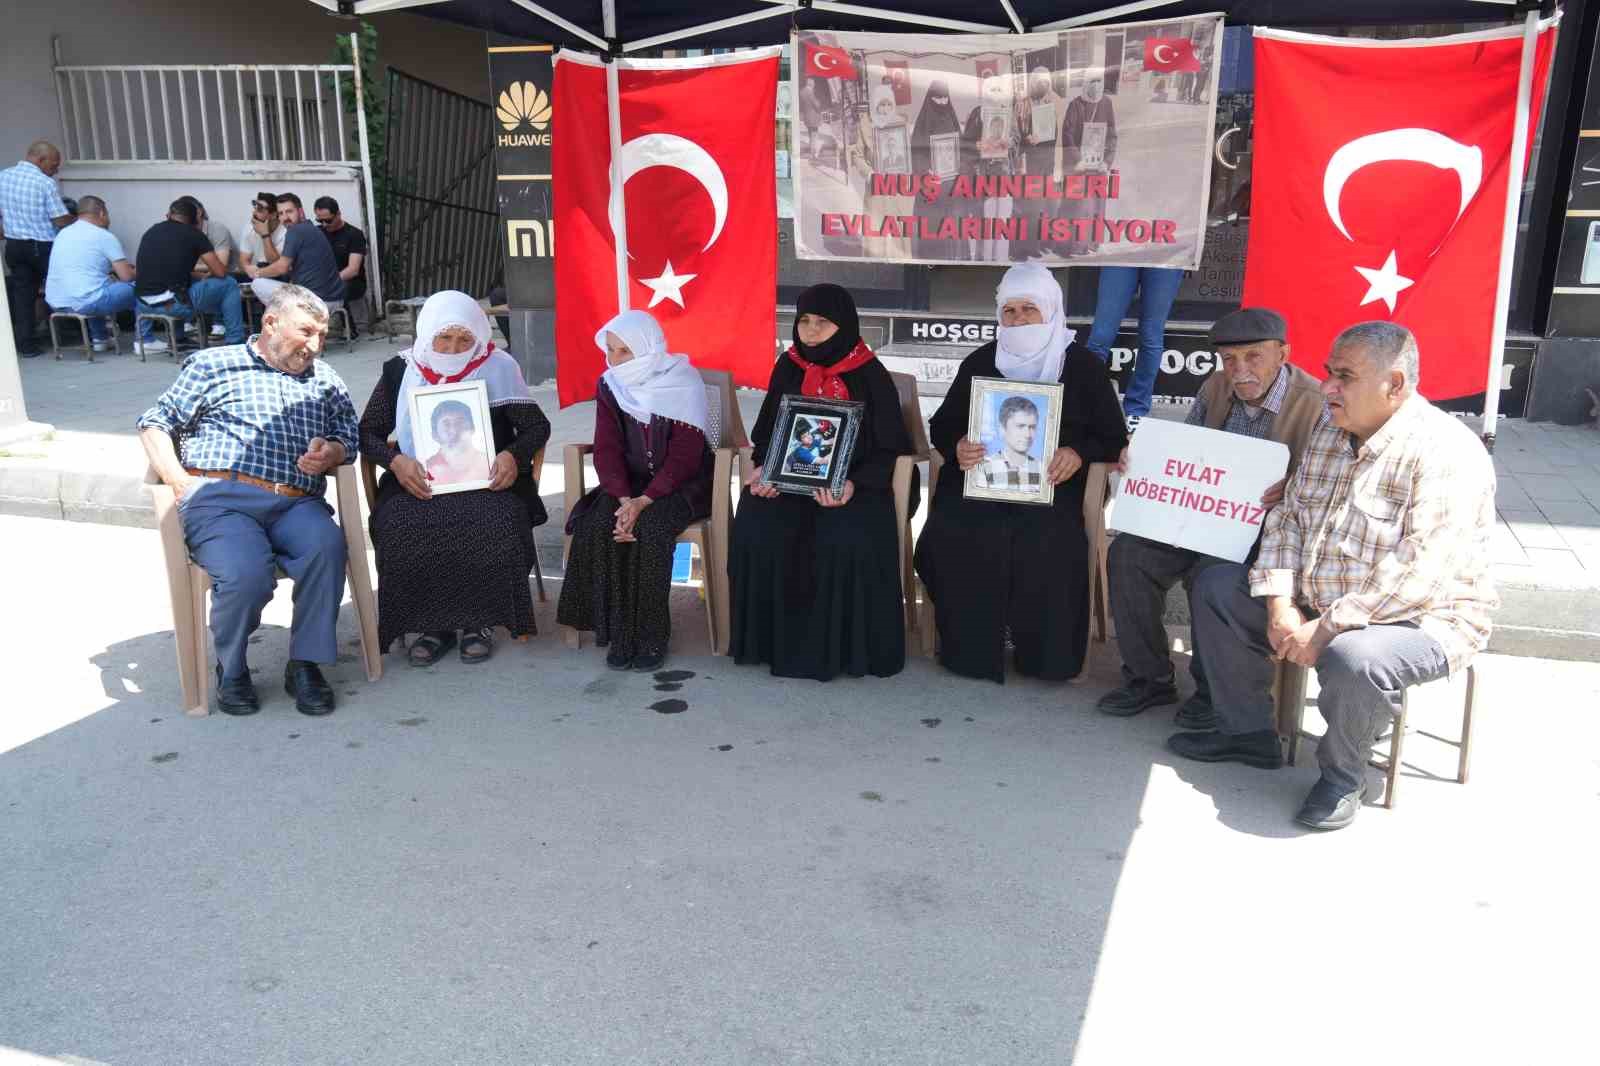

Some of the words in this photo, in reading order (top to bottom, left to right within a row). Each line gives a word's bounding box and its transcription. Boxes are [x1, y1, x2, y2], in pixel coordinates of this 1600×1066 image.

[498, 133, 553, 147] HUAWE
[872, 173, 942, 204] MUŞ
[950, 169, 1120, 200] ANNELERİ
[822, 213, 1028, 241] EVLATLARINI
[1038, 209, 1177, 245] İSTİYOR
[912, 322, 999, 343] HOŞGE
[1164, 458, 1226, 487] EVLAT
[1124, 477, 1265, 526] NÖBETİNDEYİZ
